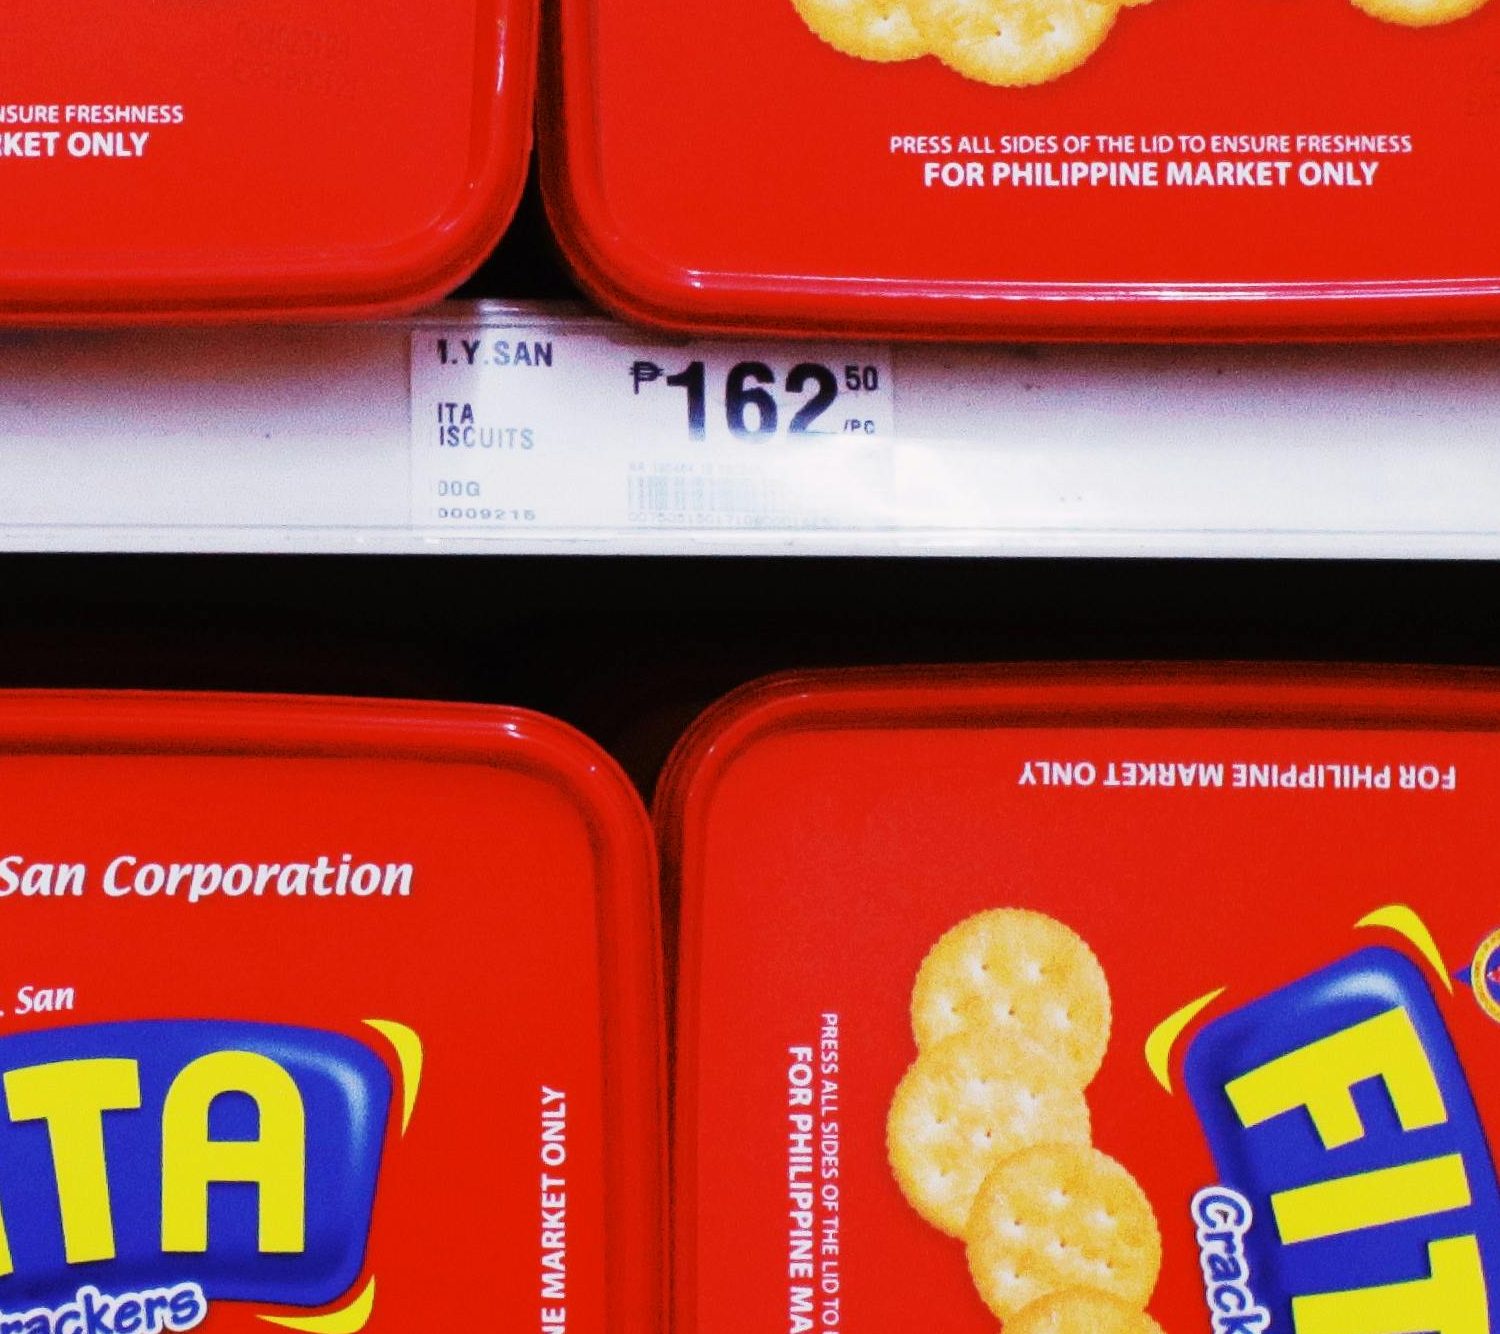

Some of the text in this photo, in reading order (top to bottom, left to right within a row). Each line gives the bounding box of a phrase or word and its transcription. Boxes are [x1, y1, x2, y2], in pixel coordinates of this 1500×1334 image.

[844, 363, 878, 390] 50
[1019, 762, 1455, 789] FOR PHILIPPINE MARKET ONLY
[103, 854, 413, 902] Corporation
